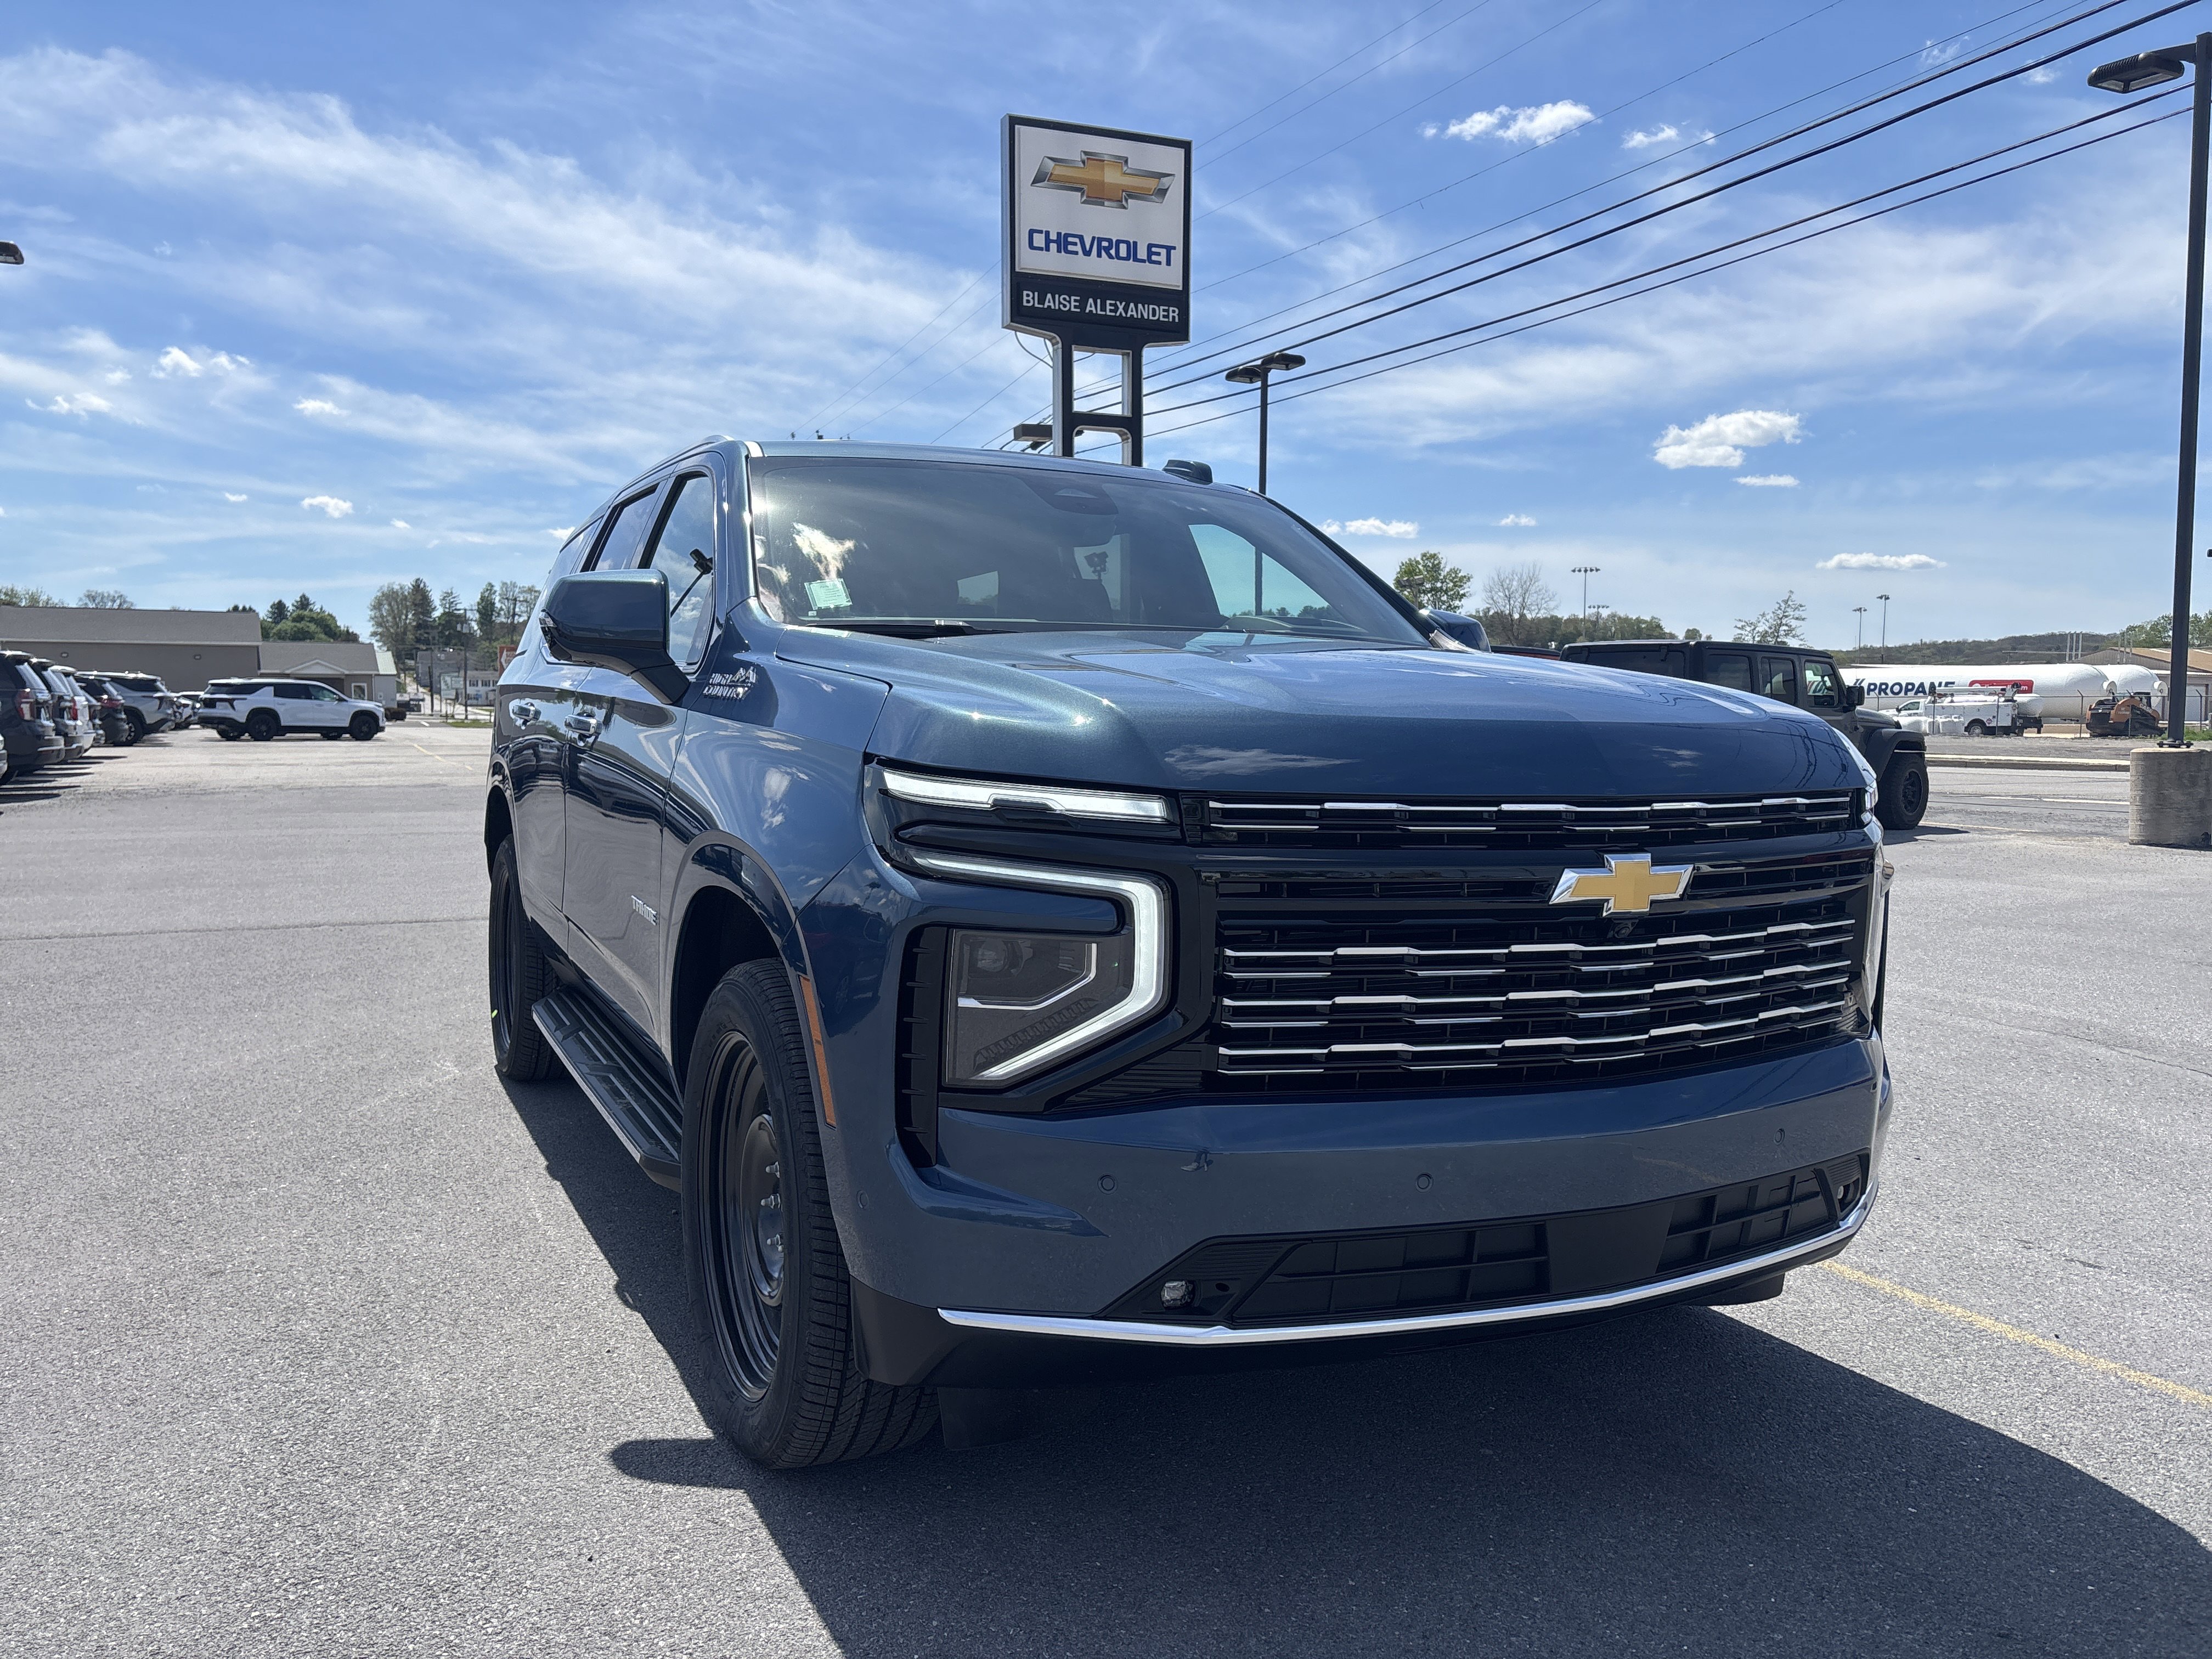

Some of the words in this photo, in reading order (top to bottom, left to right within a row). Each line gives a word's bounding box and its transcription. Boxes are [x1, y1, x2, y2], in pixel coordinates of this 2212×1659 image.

[1028, 228, 1177, 267] CHEVROLET
[1022, 290, 1081, 312] BLAISE
[1085, 298, 1179, 323] ALEXANDER
[631, 895, 657, 926] TAHOE
